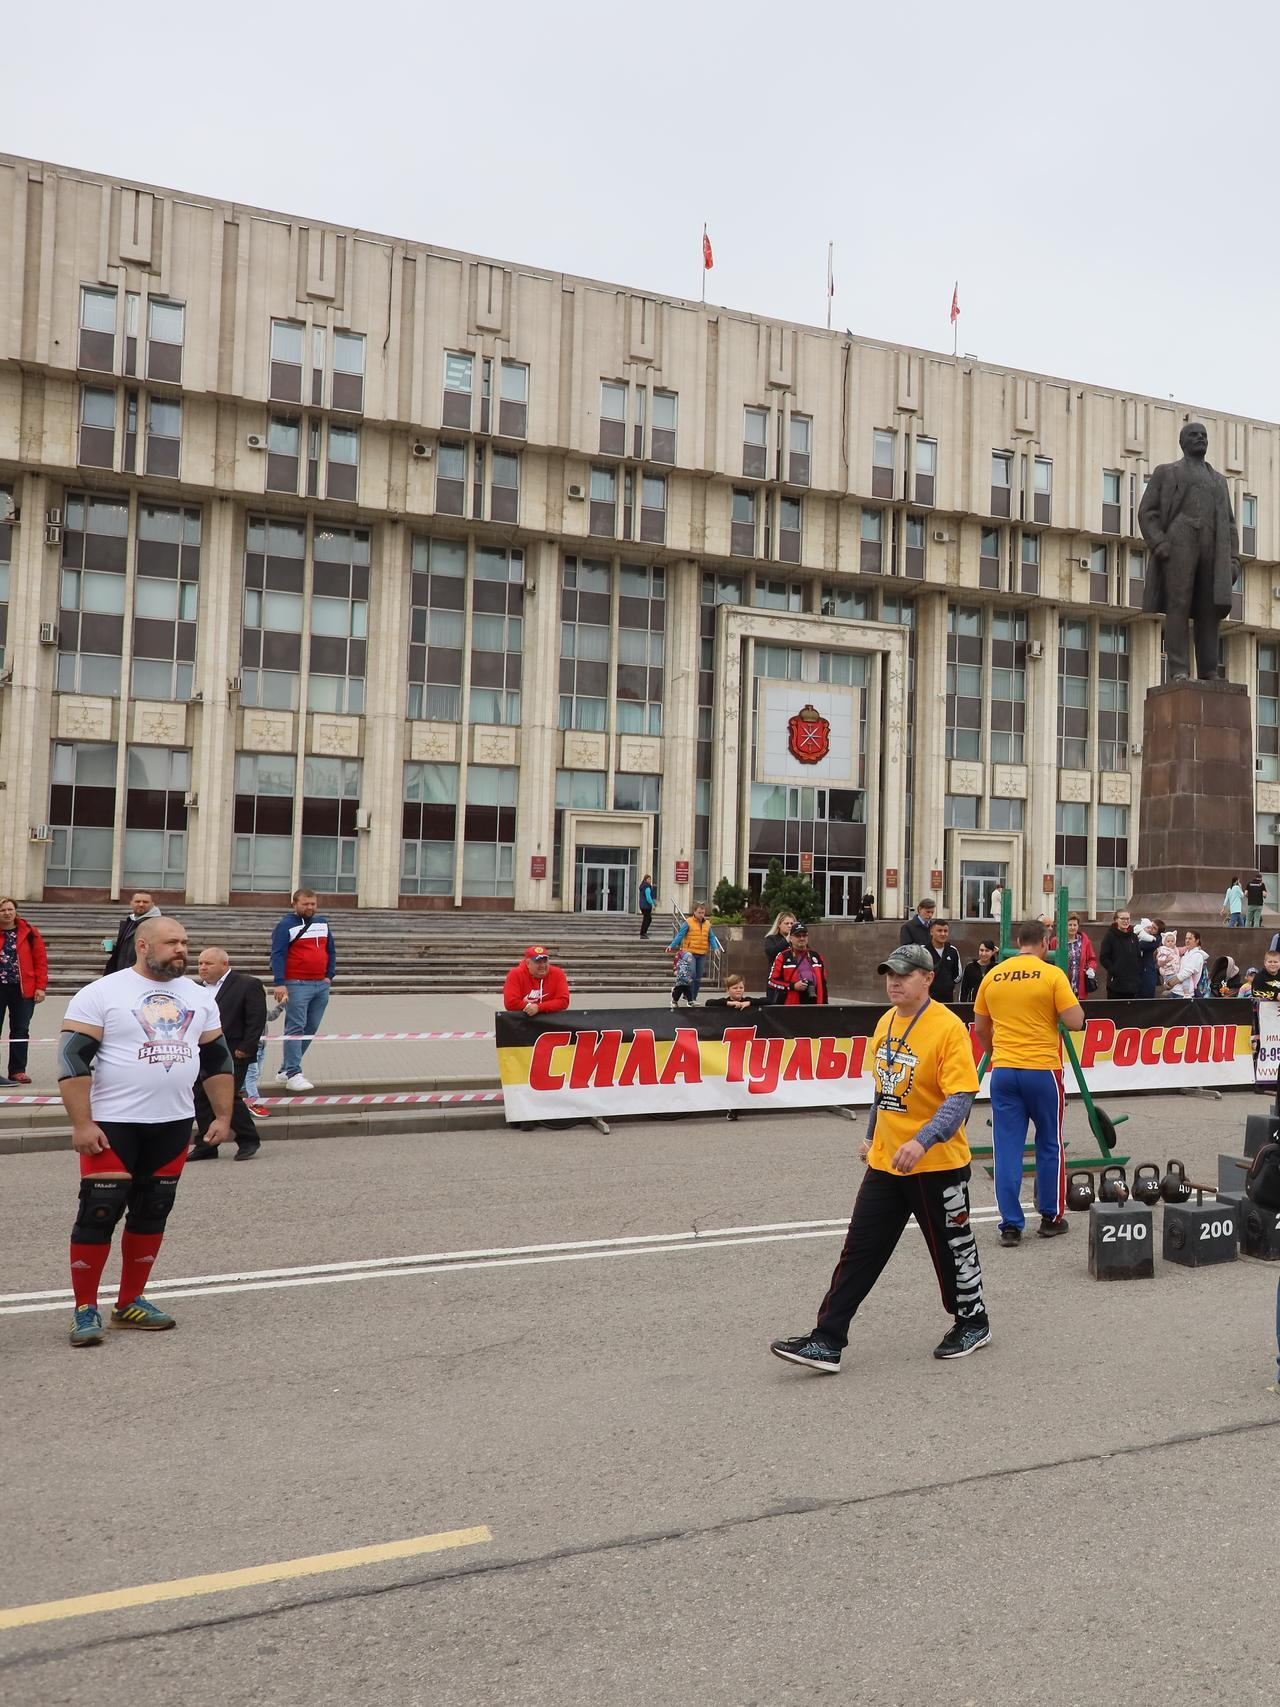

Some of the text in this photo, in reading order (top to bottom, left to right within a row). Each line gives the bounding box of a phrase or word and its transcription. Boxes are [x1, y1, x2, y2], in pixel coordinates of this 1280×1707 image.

[993, 970, 1041, 982] СУДЬЯ
[139, 1045, 192, 1059] НАЦИЯ
[1079, 1018, 1238, 1069] России
[530, 1027, 703, 1091] СИЛА
[1079, 1187, 1091, 1196] 24
[1147, 1181, 1158, 1190] 32
[1102, 1223, 1147, 1243] 240
[1200, 1219, 1234, 1241] 200
